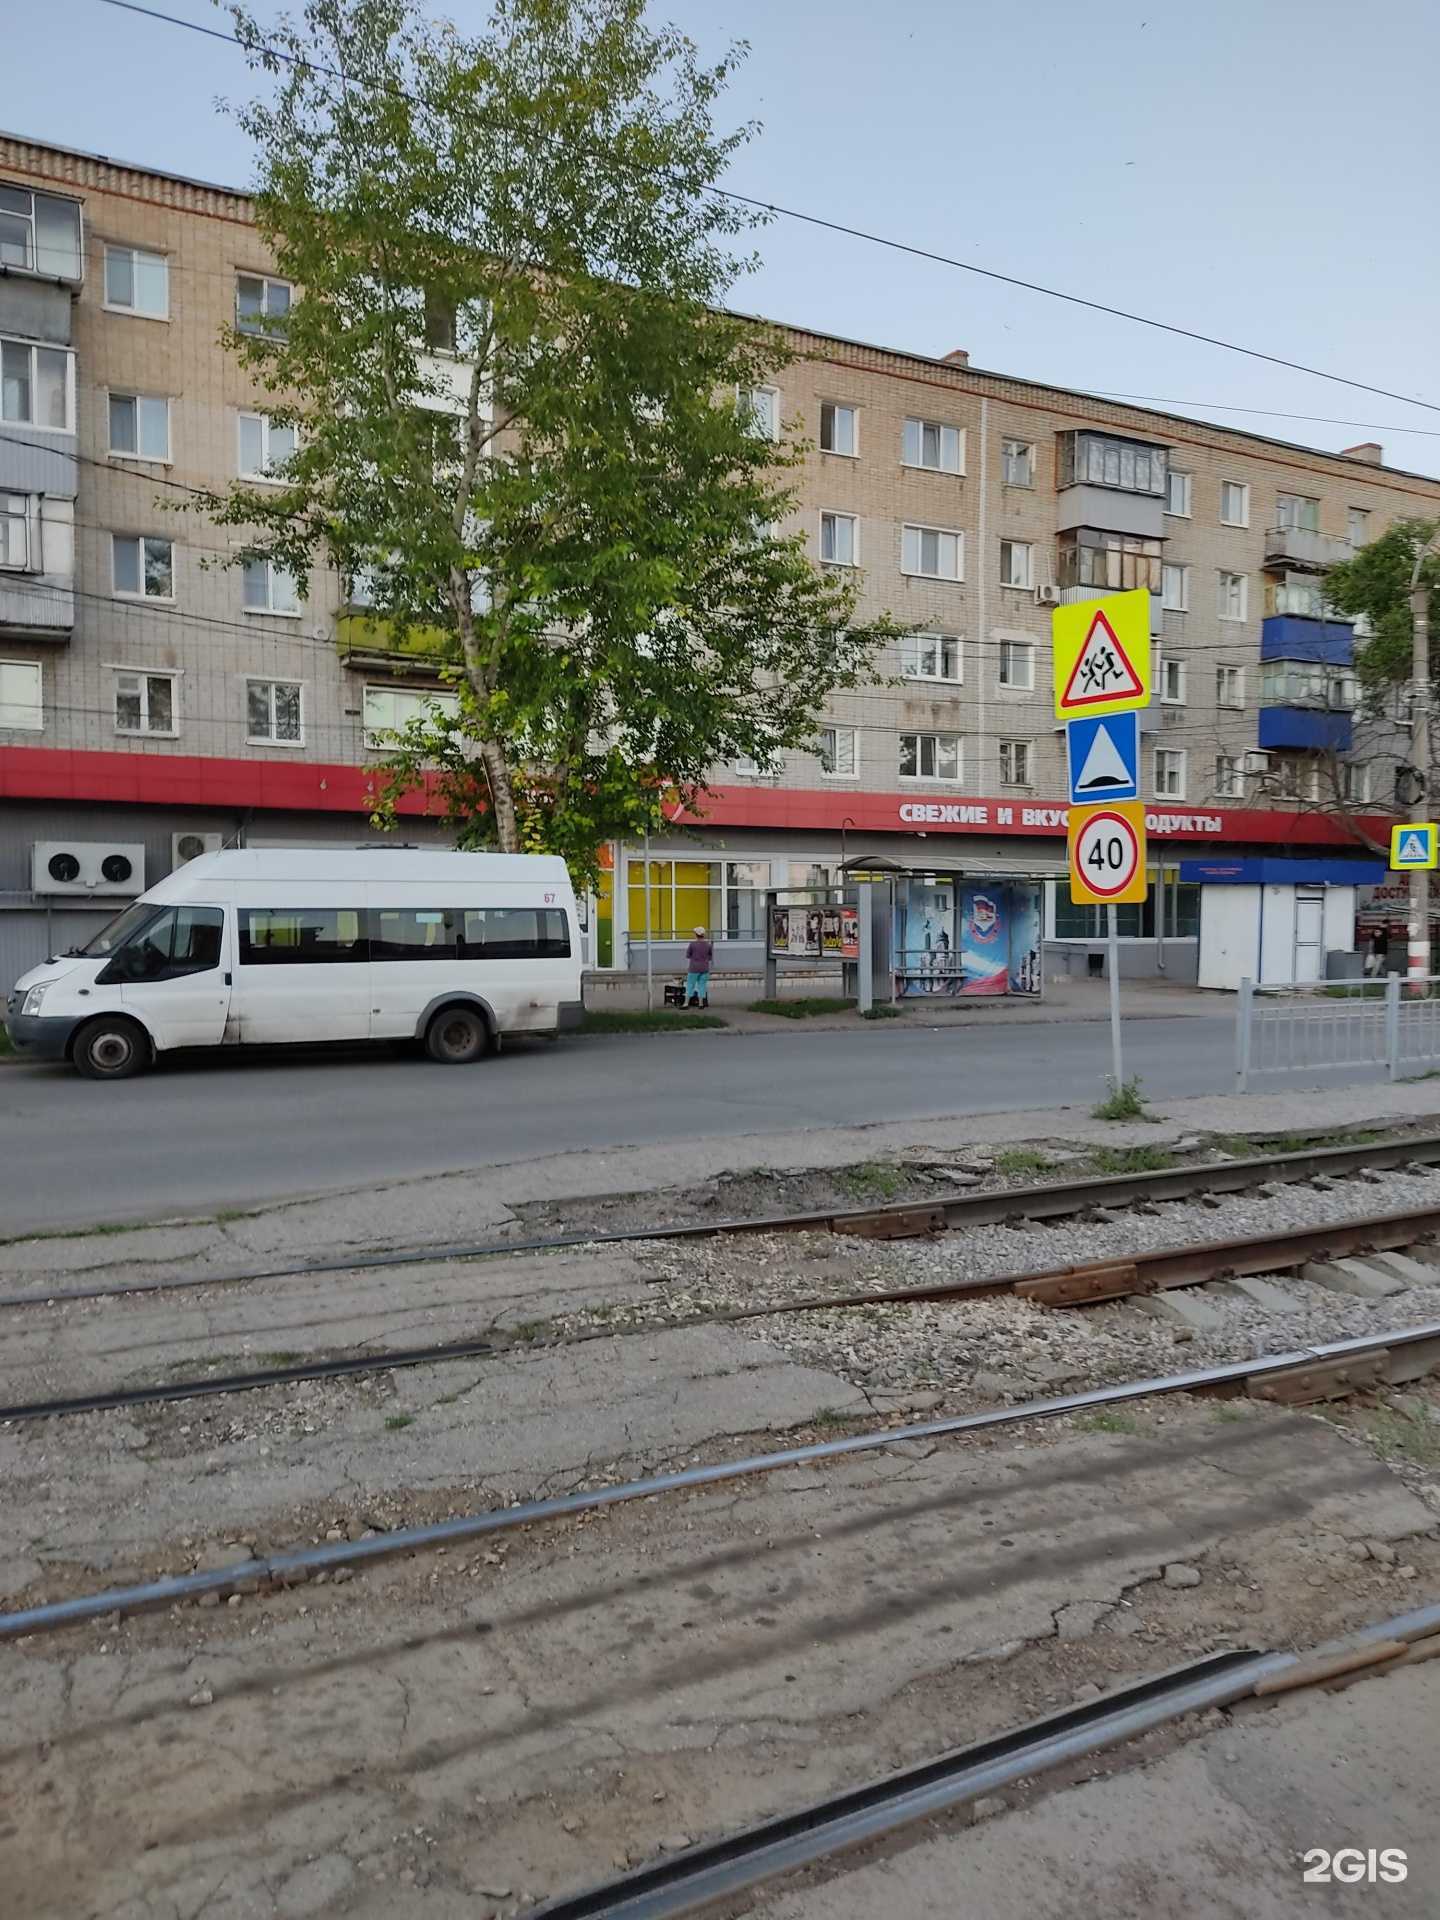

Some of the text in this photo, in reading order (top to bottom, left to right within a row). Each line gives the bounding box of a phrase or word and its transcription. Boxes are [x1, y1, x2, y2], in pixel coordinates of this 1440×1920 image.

[899, 803, 1222, 834] СВЕЖИЕ И ВКУС ОДУКТЫ
[1088, 837, 1123, 871] 40
